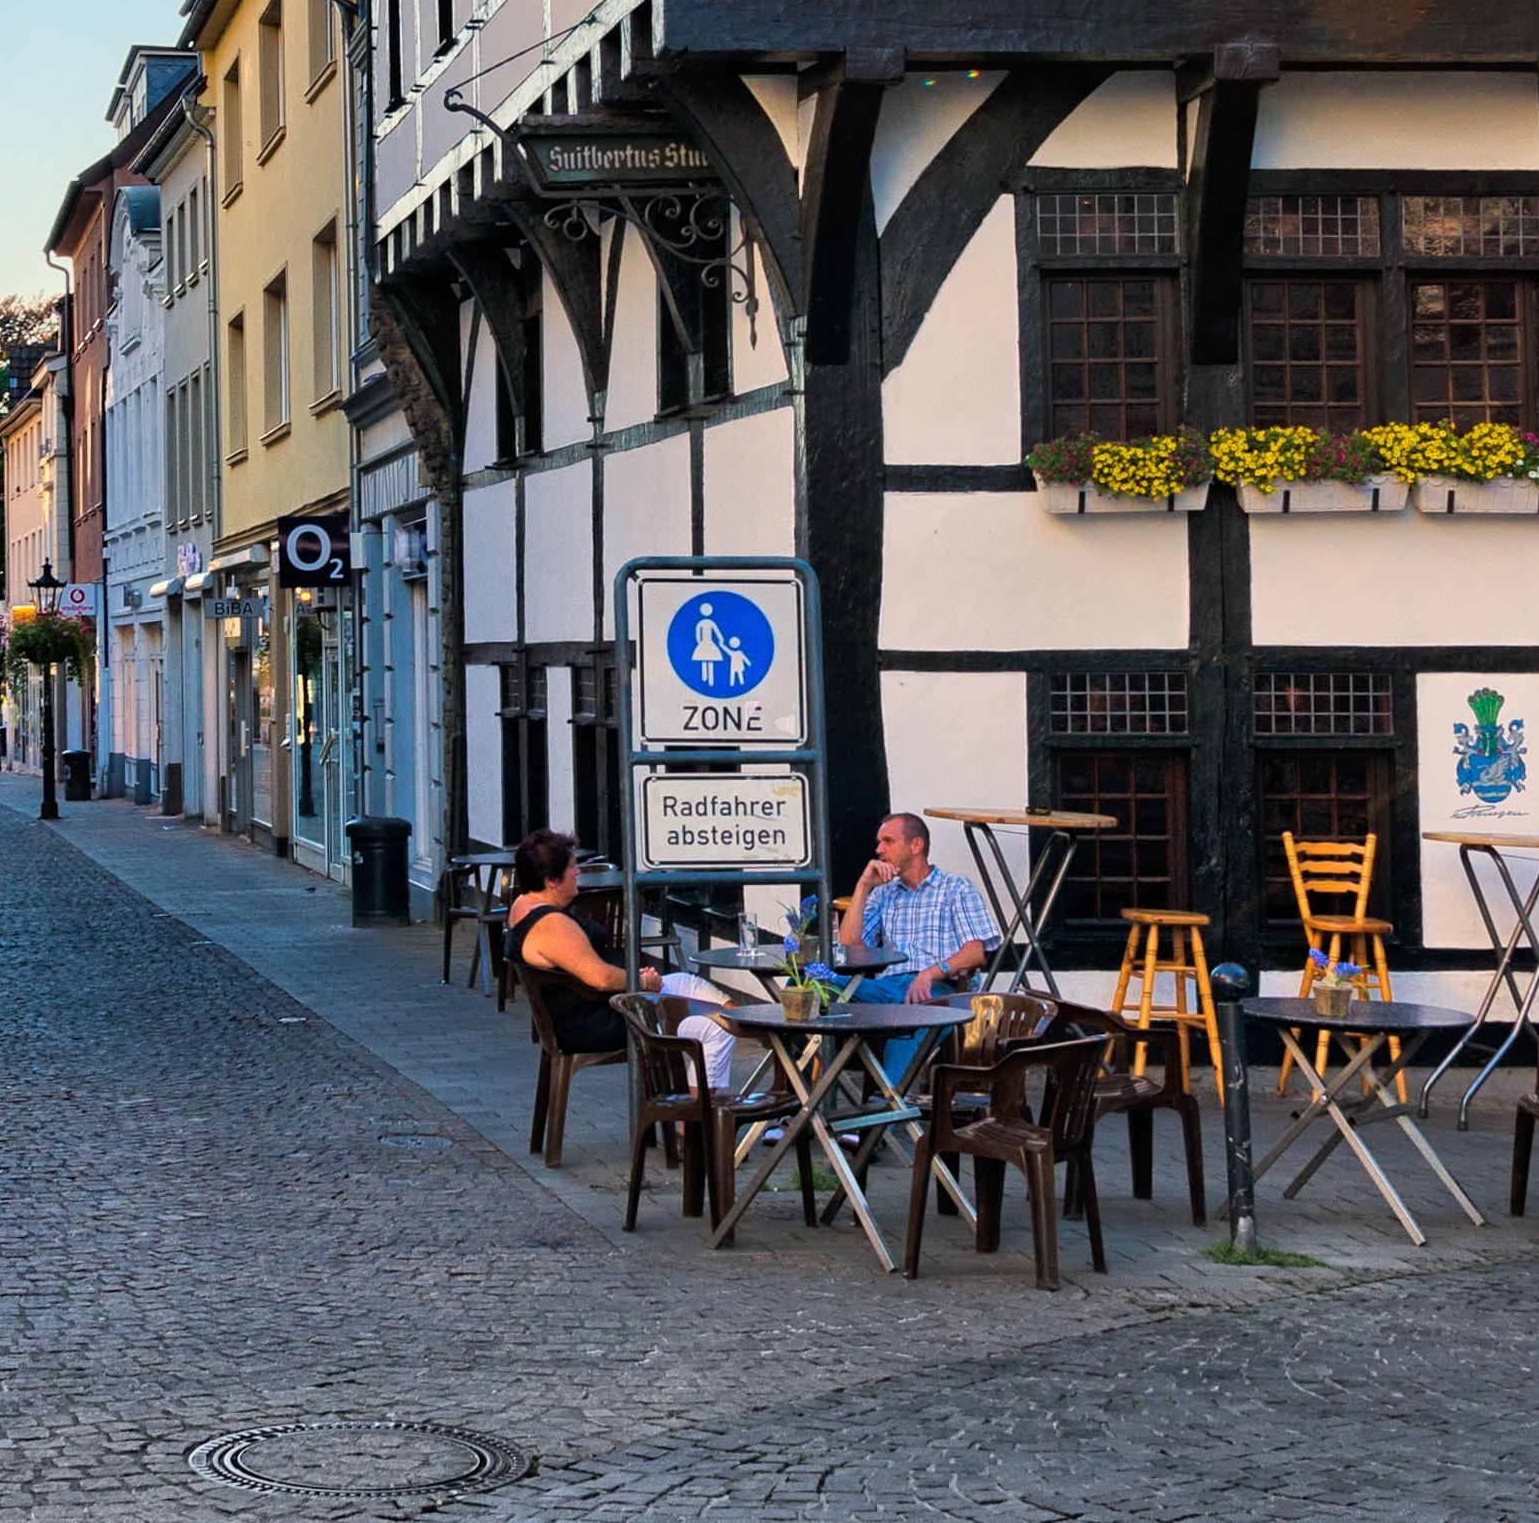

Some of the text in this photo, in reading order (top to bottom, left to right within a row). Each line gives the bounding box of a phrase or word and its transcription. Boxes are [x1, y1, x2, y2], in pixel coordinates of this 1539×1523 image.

[549, 144, 661, 172] Suitbertus
[61, 604, 94, 613] vodafone
[214, 601, 254, 616] BiBA
[682, 705, 763, 732] ZONE
[662, 795, 787, 817] Radfahrer
[667, 823, 786, 851] absteigen
